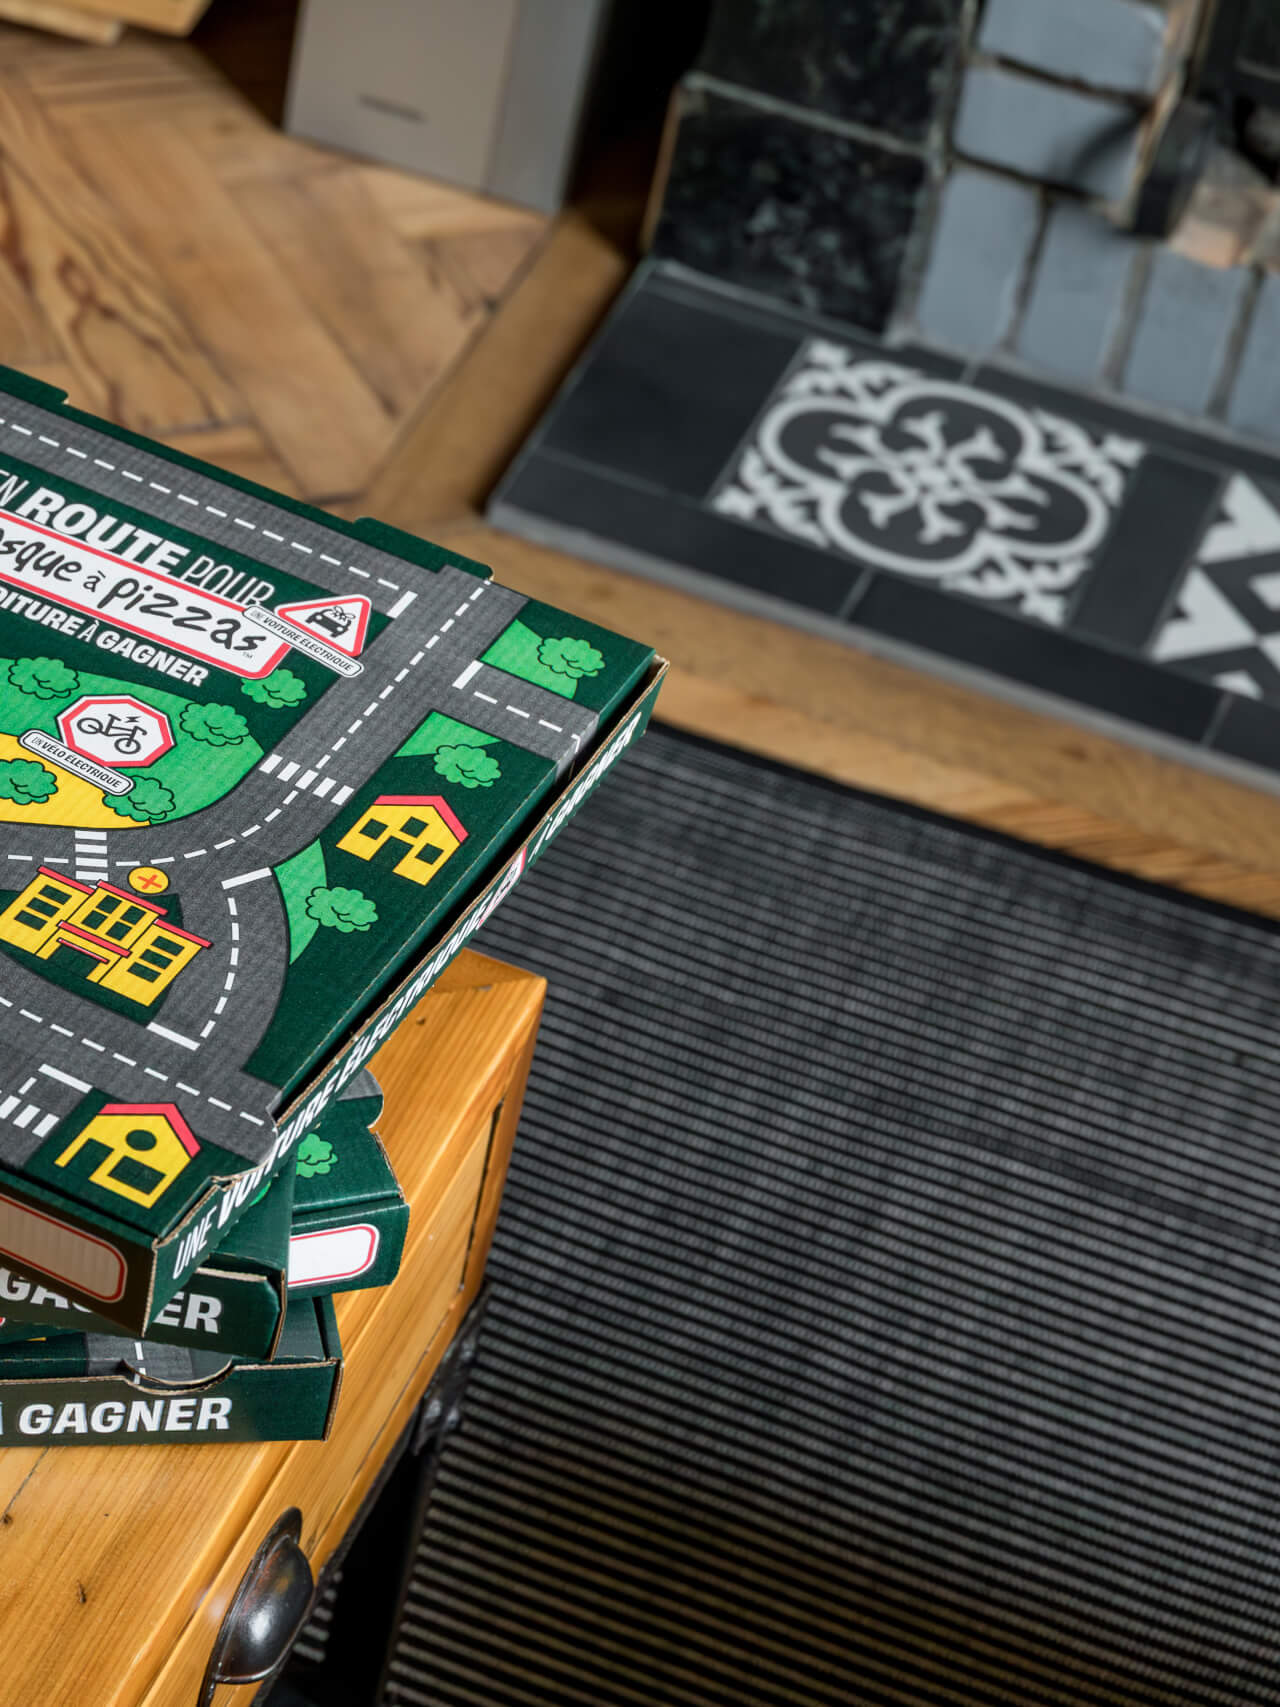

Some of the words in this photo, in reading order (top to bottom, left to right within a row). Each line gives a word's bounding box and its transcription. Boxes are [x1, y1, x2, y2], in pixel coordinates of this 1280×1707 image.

[16, 487, 191, 578] ROUTE
[179, 555, 275, 605] POUR
[83, 570, 106, 593] à
[97, 578, 267, 650] pizzas
[263, 616, 302, 643] VOITURE
[77, 619, 100, 643] À
[95, 630, 209, 687] GAGNER
[173, 1205, 218, 1279] UNE
[19, 1397, 233, 1435] GAGNER
